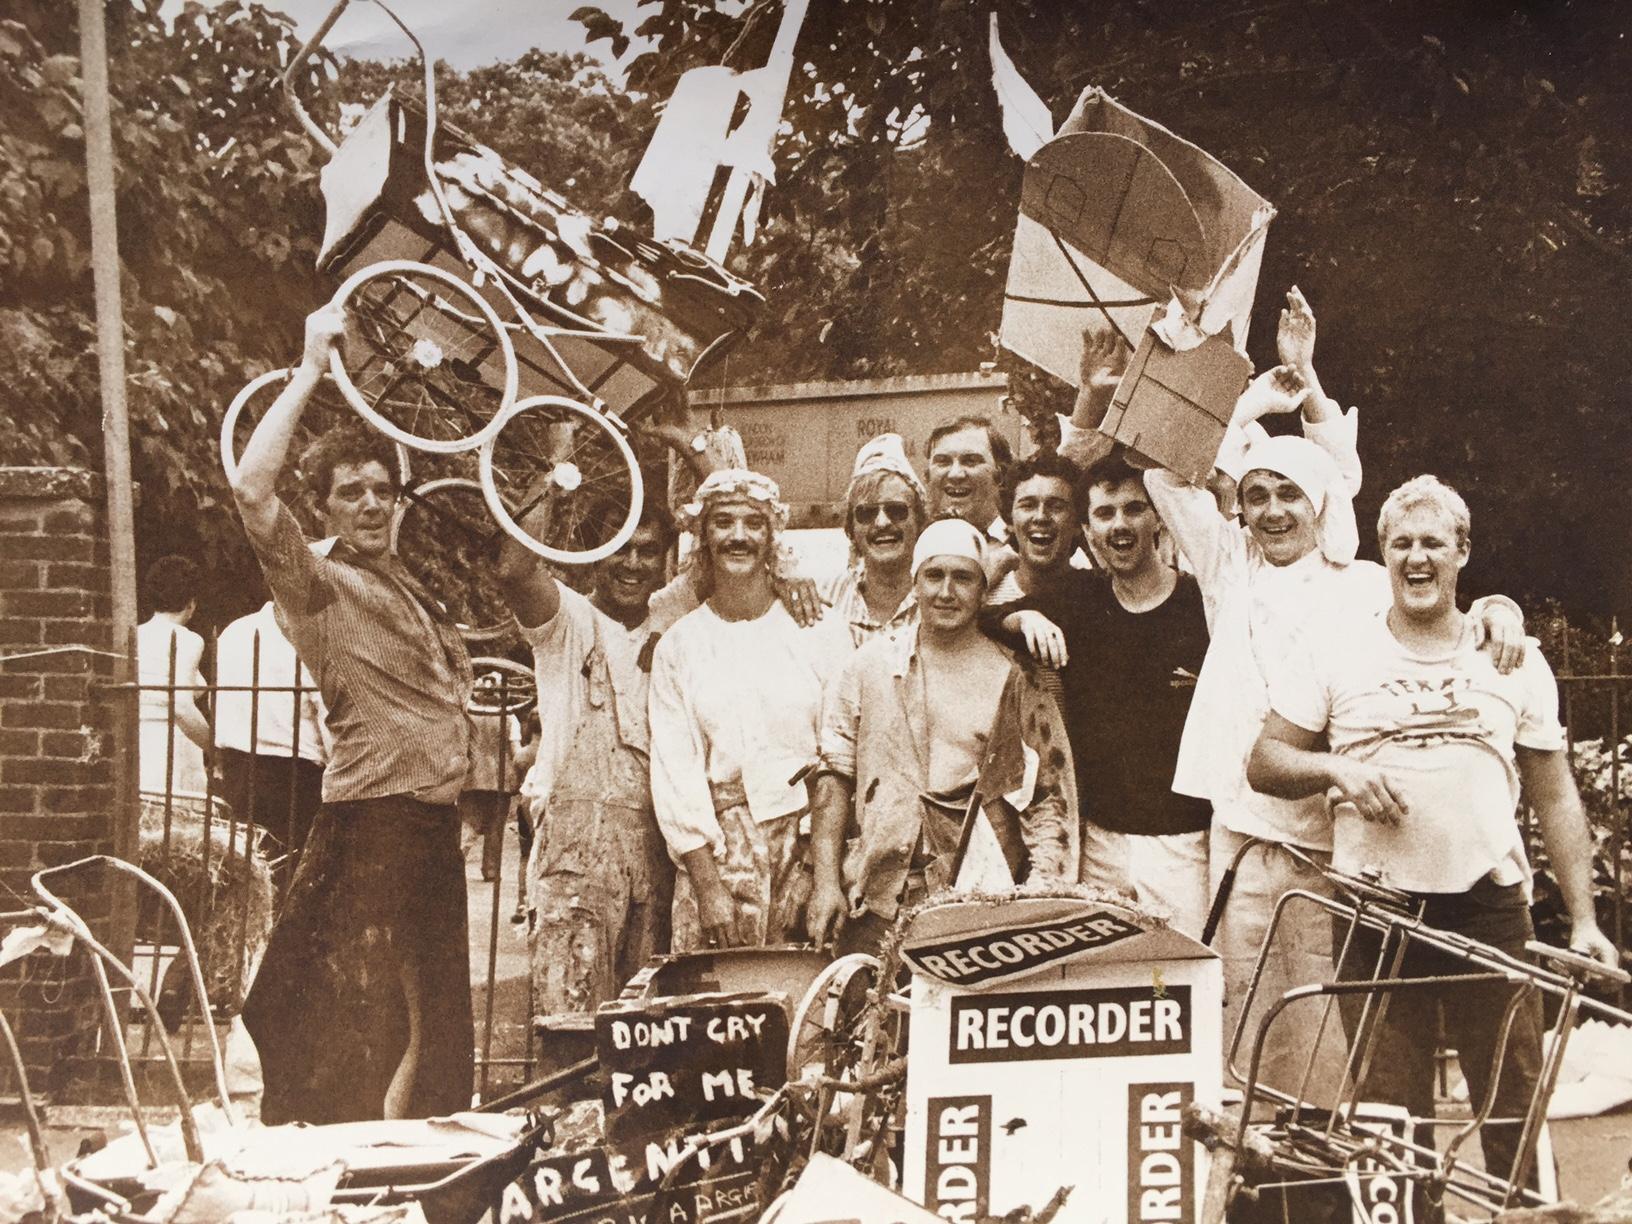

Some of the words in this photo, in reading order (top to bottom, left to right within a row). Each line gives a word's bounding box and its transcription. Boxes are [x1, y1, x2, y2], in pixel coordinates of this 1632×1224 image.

[919, 918, 1129, 981] RECORDER
[611, 1016, 692, 1049] DONT
[707, 1013, 766, 1044] CRY
[956, 1000, 1183, 1050] RECORDER
[702, 1069, 757, 1101] ME
[1140, 1091, 1182, 1224] RDER
